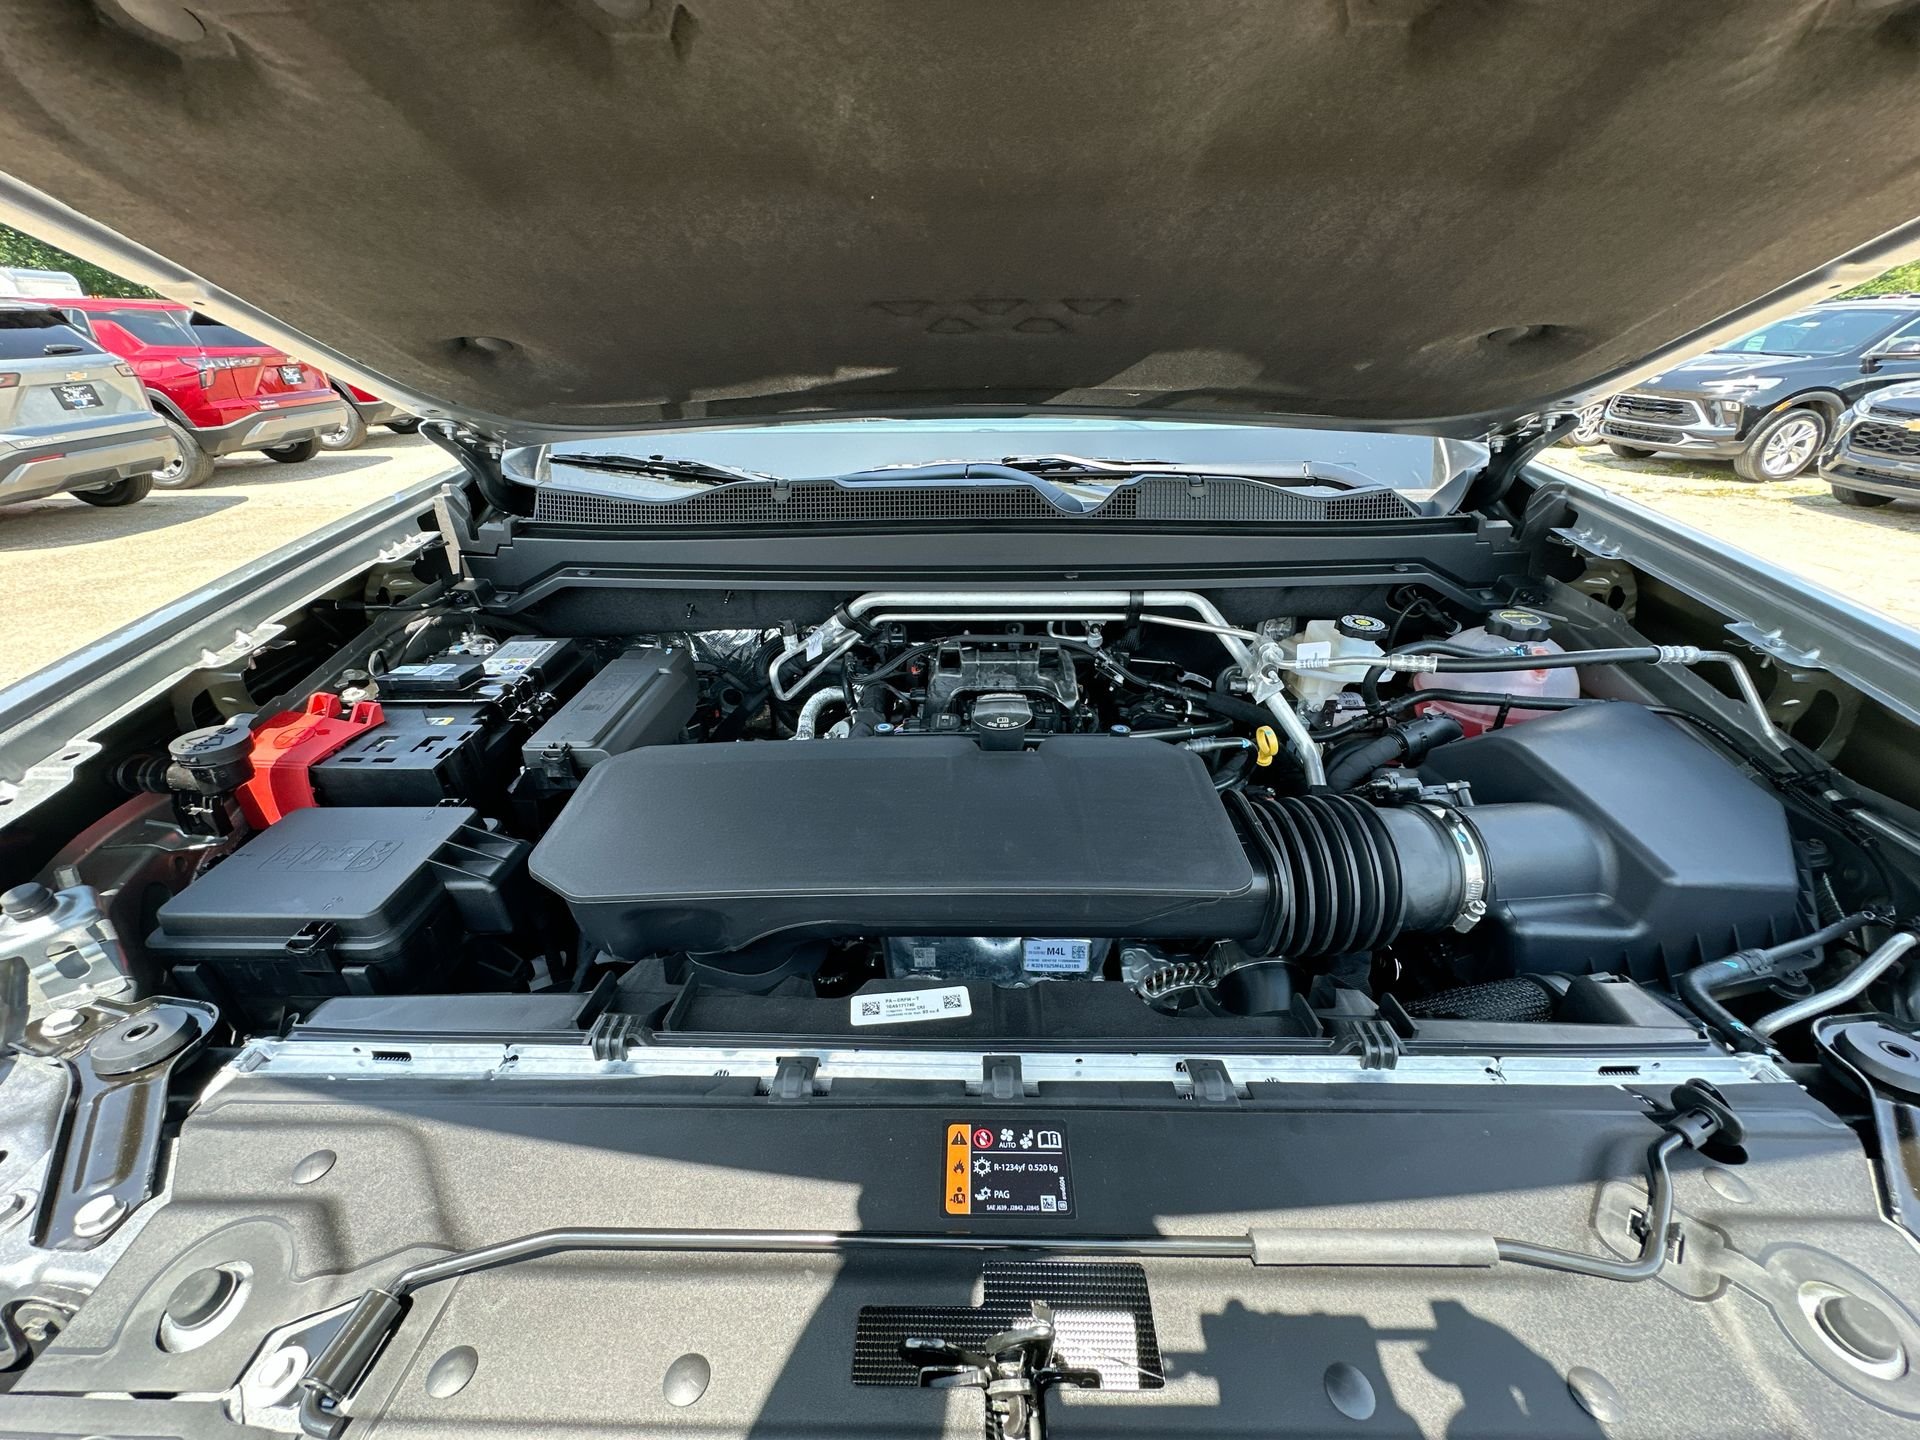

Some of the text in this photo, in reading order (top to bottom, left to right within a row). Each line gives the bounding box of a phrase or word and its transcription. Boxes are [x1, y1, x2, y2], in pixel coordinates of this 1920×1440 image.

[1046, 947, 1066, 956] M4L
[993, 1164, 1059, 1174] R-1234yf 0.520 kg
[993, 1190, 1010, 1199] PAG
